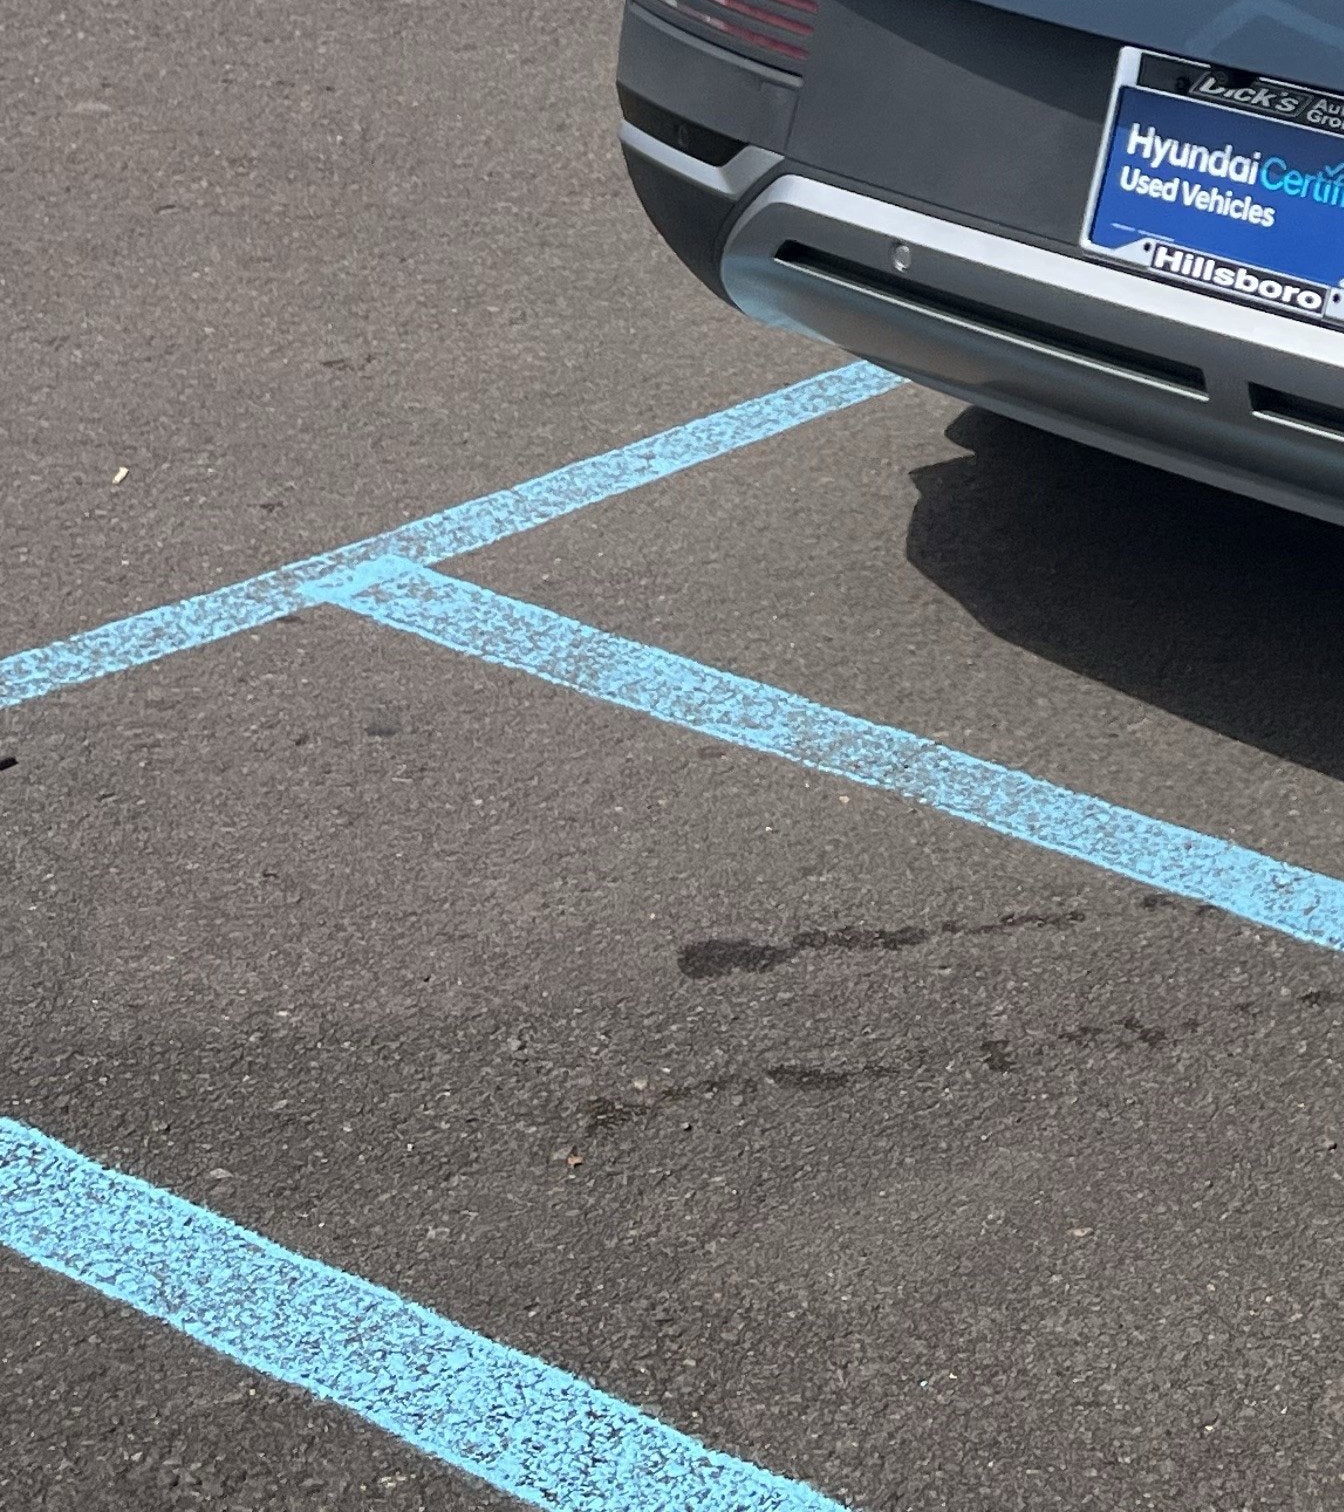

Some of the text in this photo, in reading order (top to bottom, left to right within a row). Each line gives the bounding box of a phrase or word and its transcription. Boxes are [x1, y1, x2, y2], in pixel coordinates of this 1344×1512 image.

[1126, 122, 1261, 185] Hyundai
[1119, 164, 1276, 228] Used Vehicles
[1154, 245, 1322, 310] Hillsboro
